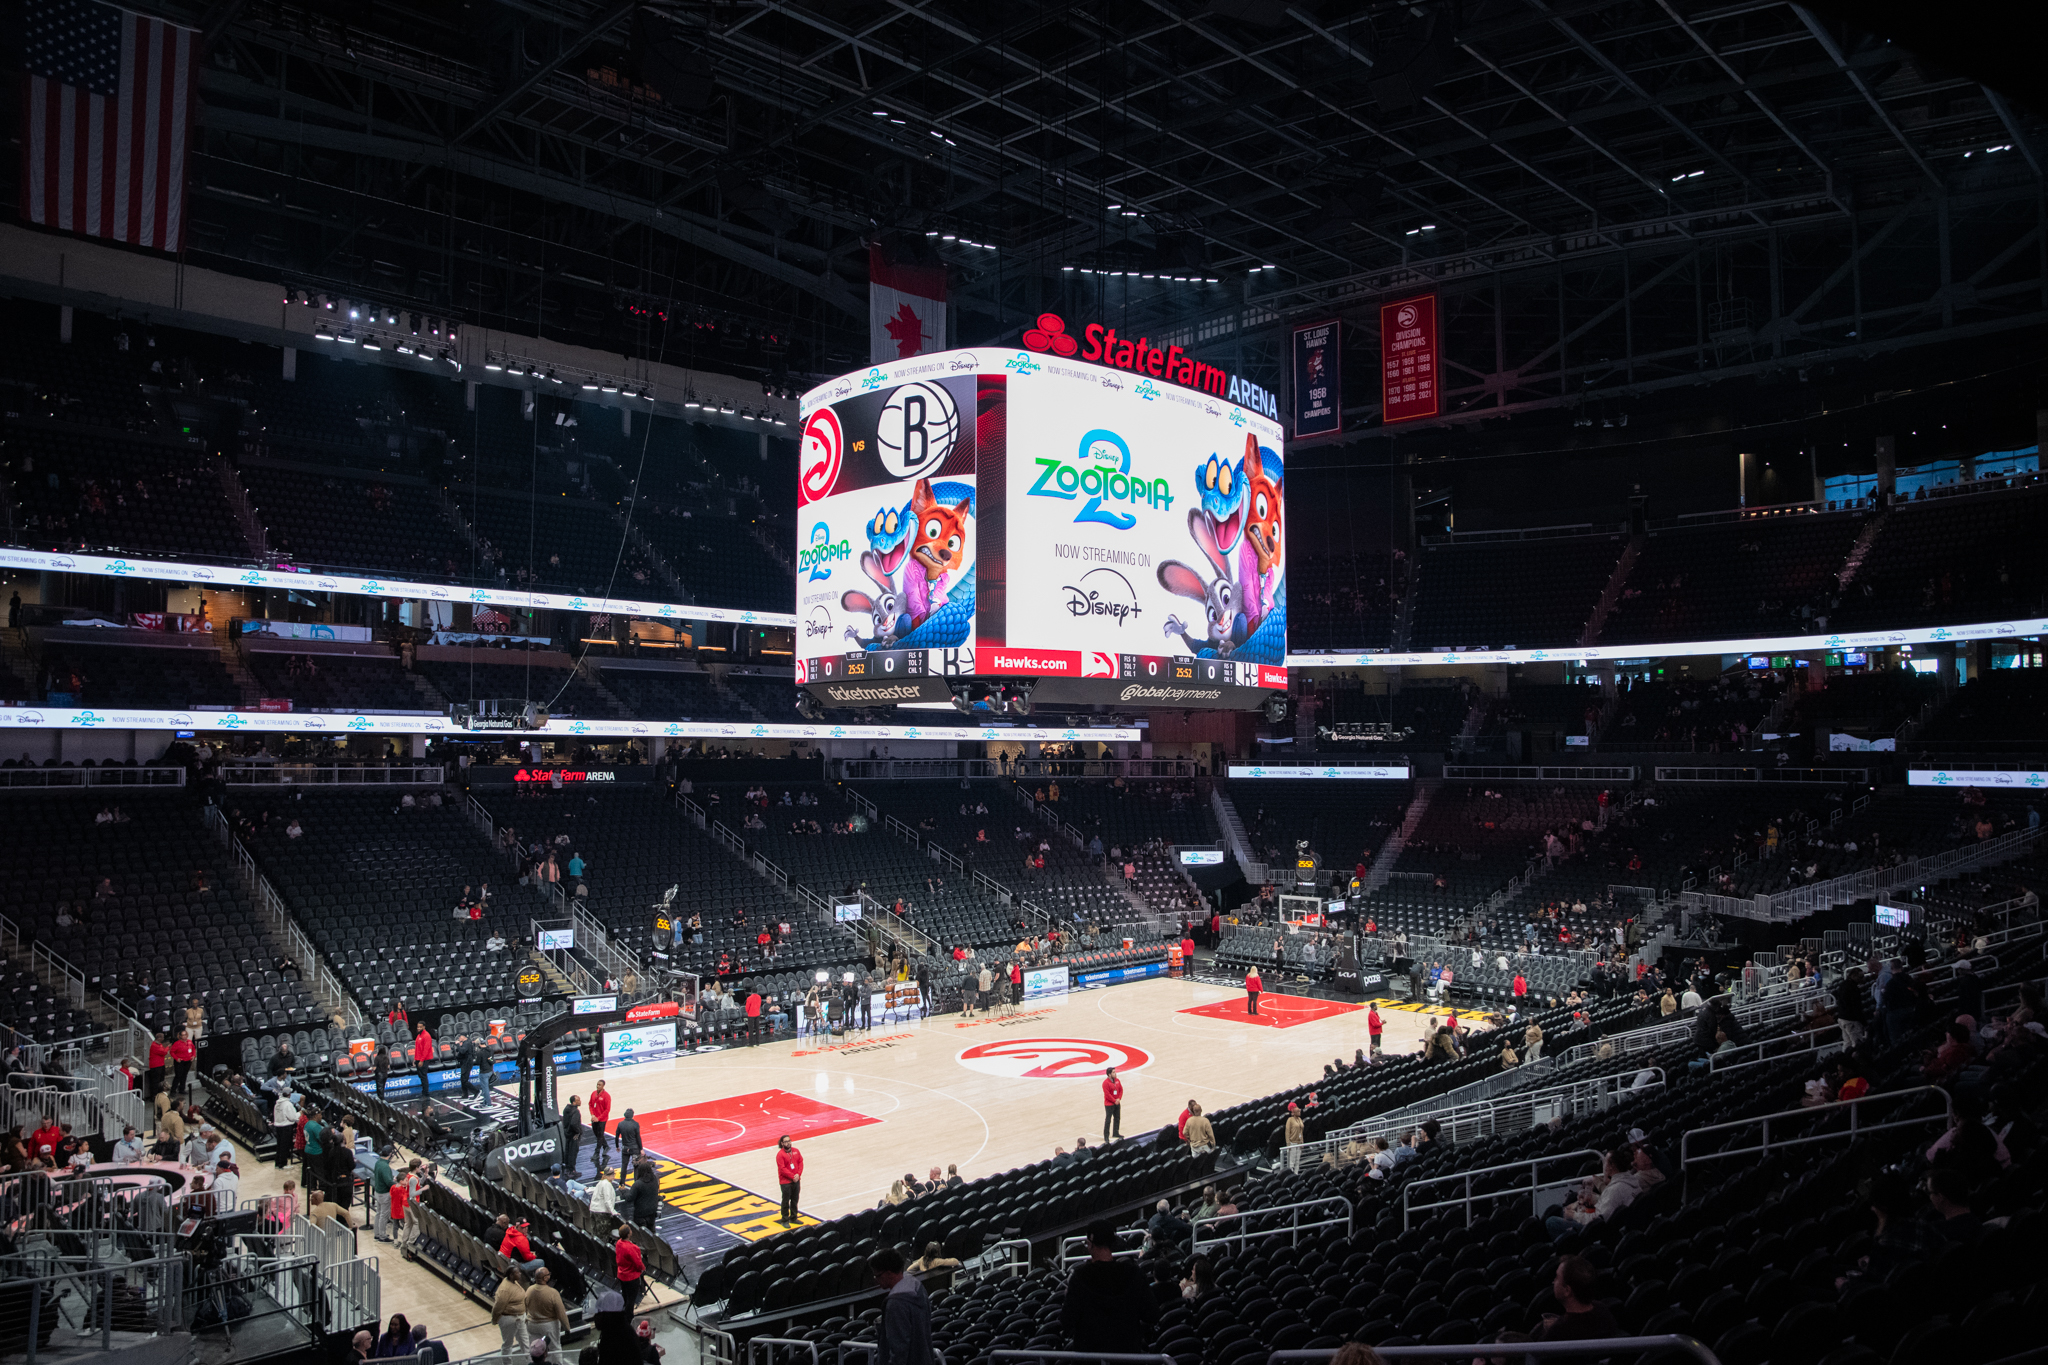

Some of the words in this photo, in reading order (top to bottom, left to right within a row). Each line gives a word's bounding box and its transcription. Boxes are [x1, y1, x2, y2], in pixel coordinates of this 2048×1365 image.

[1313, 327, 1329, 338] LOUIS
[1396, 328, 1421, 341] DIVISION
[1306, 337, 1327, 348] HAWKS
[1392, 337, 1426, 351] CHAMPIONS
[894, 369, 907, 378] NOW
[909, 364, 936, 376] STREAMING
[938, 363, 944, 371] ON
[949, 361, 980, 371] Disney+
[1005, 359, 1041, 372] ZOOTOPIA
[1016, 353, 1031, 375] 2
[868, 368, 880, 390] 2
[1047, 366, 1060, 376] NOW
[1062, 368, 1089, 381] STREAMING
[1091, 373, 1097, 382] ON
[862, 374, 888, 388] ZOOTOPIA
[1100, 377, 1124, 392] Disney+
[1135, 384, 1161, 398] ZOOTOPIA
[1142, 379, 1154, 401] 2
[1309, 387, 1327, 400] 1958
[1166, 392, 1175, 402] NOW
[1176, 395, 1196, 408] STREAMING
[1198, 400, 1202, 409] ON
[1228, 375, 1278, 420] ARENA
[1313, 400, 1322, 408] NBA
[1204, 403, 1221, 418] Disney+
[1304, 407, 1331, 419] CHAMPIONS
[904, 395, 928, 467] B
[1092, 446, 1119, 465] Disney
[1027, 457, 1174, 511] ZOOTOPIA
[1073, 429, 1136, 530] 2
[798, 539, 852, 574] ZOOTOPIA
[808, 521, 831, 583] 2
[1055, 544, 1080, 559] NOW
[1083, 547, 1135, 566] STREAMING
[1138, 553, 1150, 568] ON
[12, 556, 38, 564] STREAMING
[50, 559, 76, 570] Disney+
[192, 571, 215, 580] Disney+
[317, 580, 337, 588] Disney+
[811, 592, 831, 603] STREAMING
[832, 590, 838, 599] ON
[1062, 586, 1142, 627] Disney+
[805, 620, 833, 639] Disney+
[826, 662, 832, 676] 0
[848, 664, 864, 674] 25:52
[884, 658, 894, 672] 0
[994, 656, 1067, 670] Hawks.com
[1149, 662, 1157, 676] 0
[1176, 668, 1192, 678] 25:52
[1208, 666, 1215, 679] 0
[828, 685, 920, 700] ticketmaster
[16, 716, 45, 725] Disney+
[81, 711, 95, 726] 2
[168, 718, 194, 726] Disney+
[303, 720, 326, 729] Disney+
[474, 720, 488, 729] Georgia
[425, 722, 444, 730] Disney+
[586, 772, 615, 780] ARENA
[1084, 972, 1110, 980] ticketmaster
[1123, 967, 1146, 975] ticketmaster
[520, 974, 540, 983] 25:52
[1364, 974, 1381, 986] paze
[998, 1016, 1049, 1028] ARENA
[361, 1044, 368, 1052] G
[609, 1038, 643, 1050] ZOOTOPIA
[618, 1033, 633, 1053] 2
[840, 1043, 900, 1056] ARENA
[504, 1139, 555, 1165] paze
